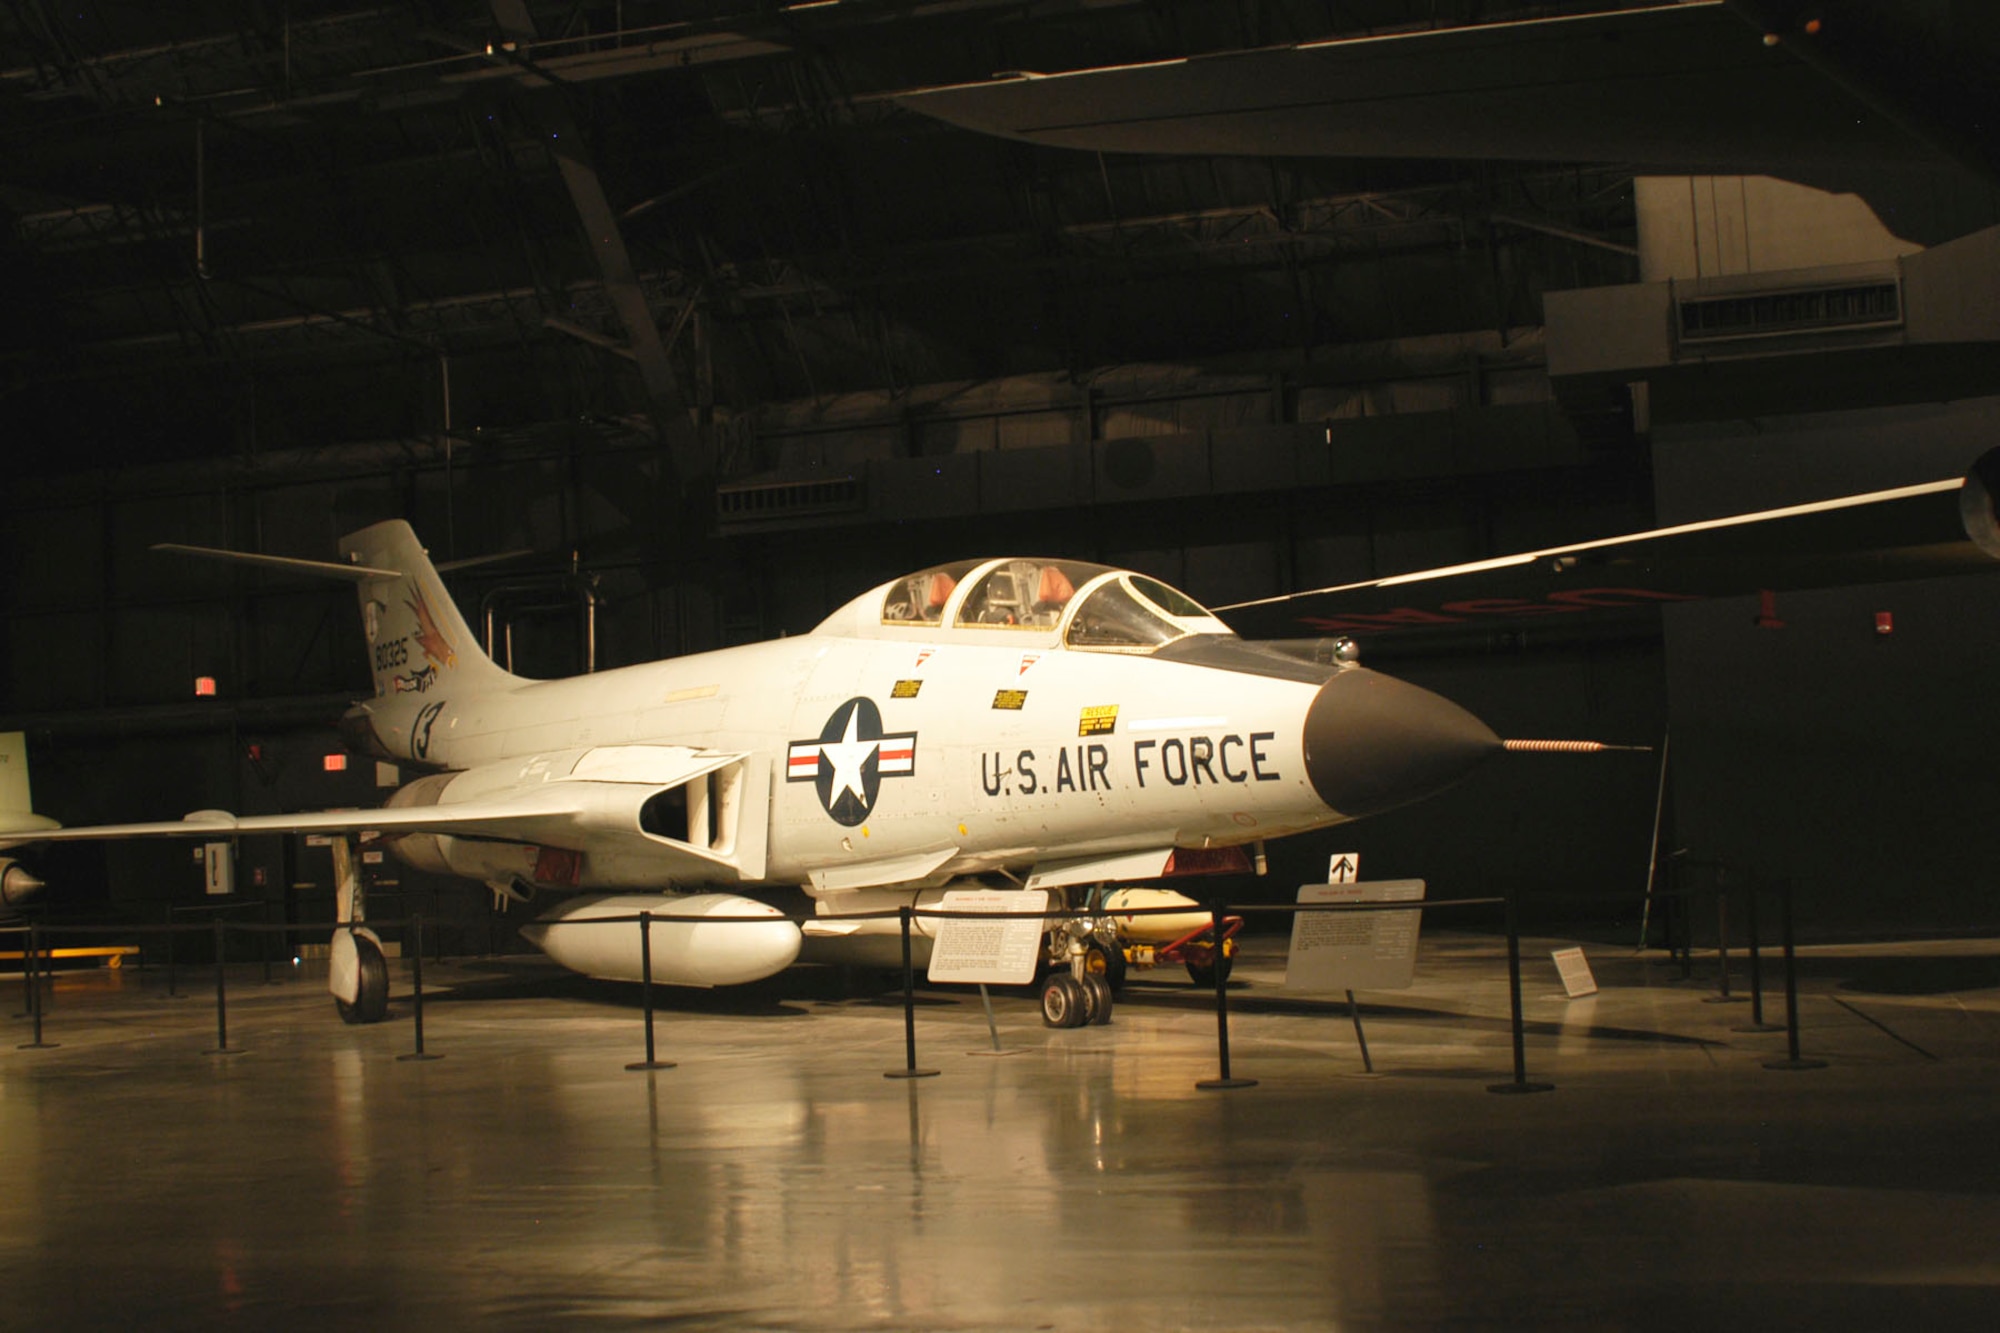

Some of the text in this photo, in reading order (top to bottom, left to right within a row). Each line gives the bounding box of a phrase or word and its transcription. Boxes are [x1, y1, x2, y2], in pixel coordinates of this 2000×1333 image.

[982, 731, 1281, 796] U.S. AIR FORCE
